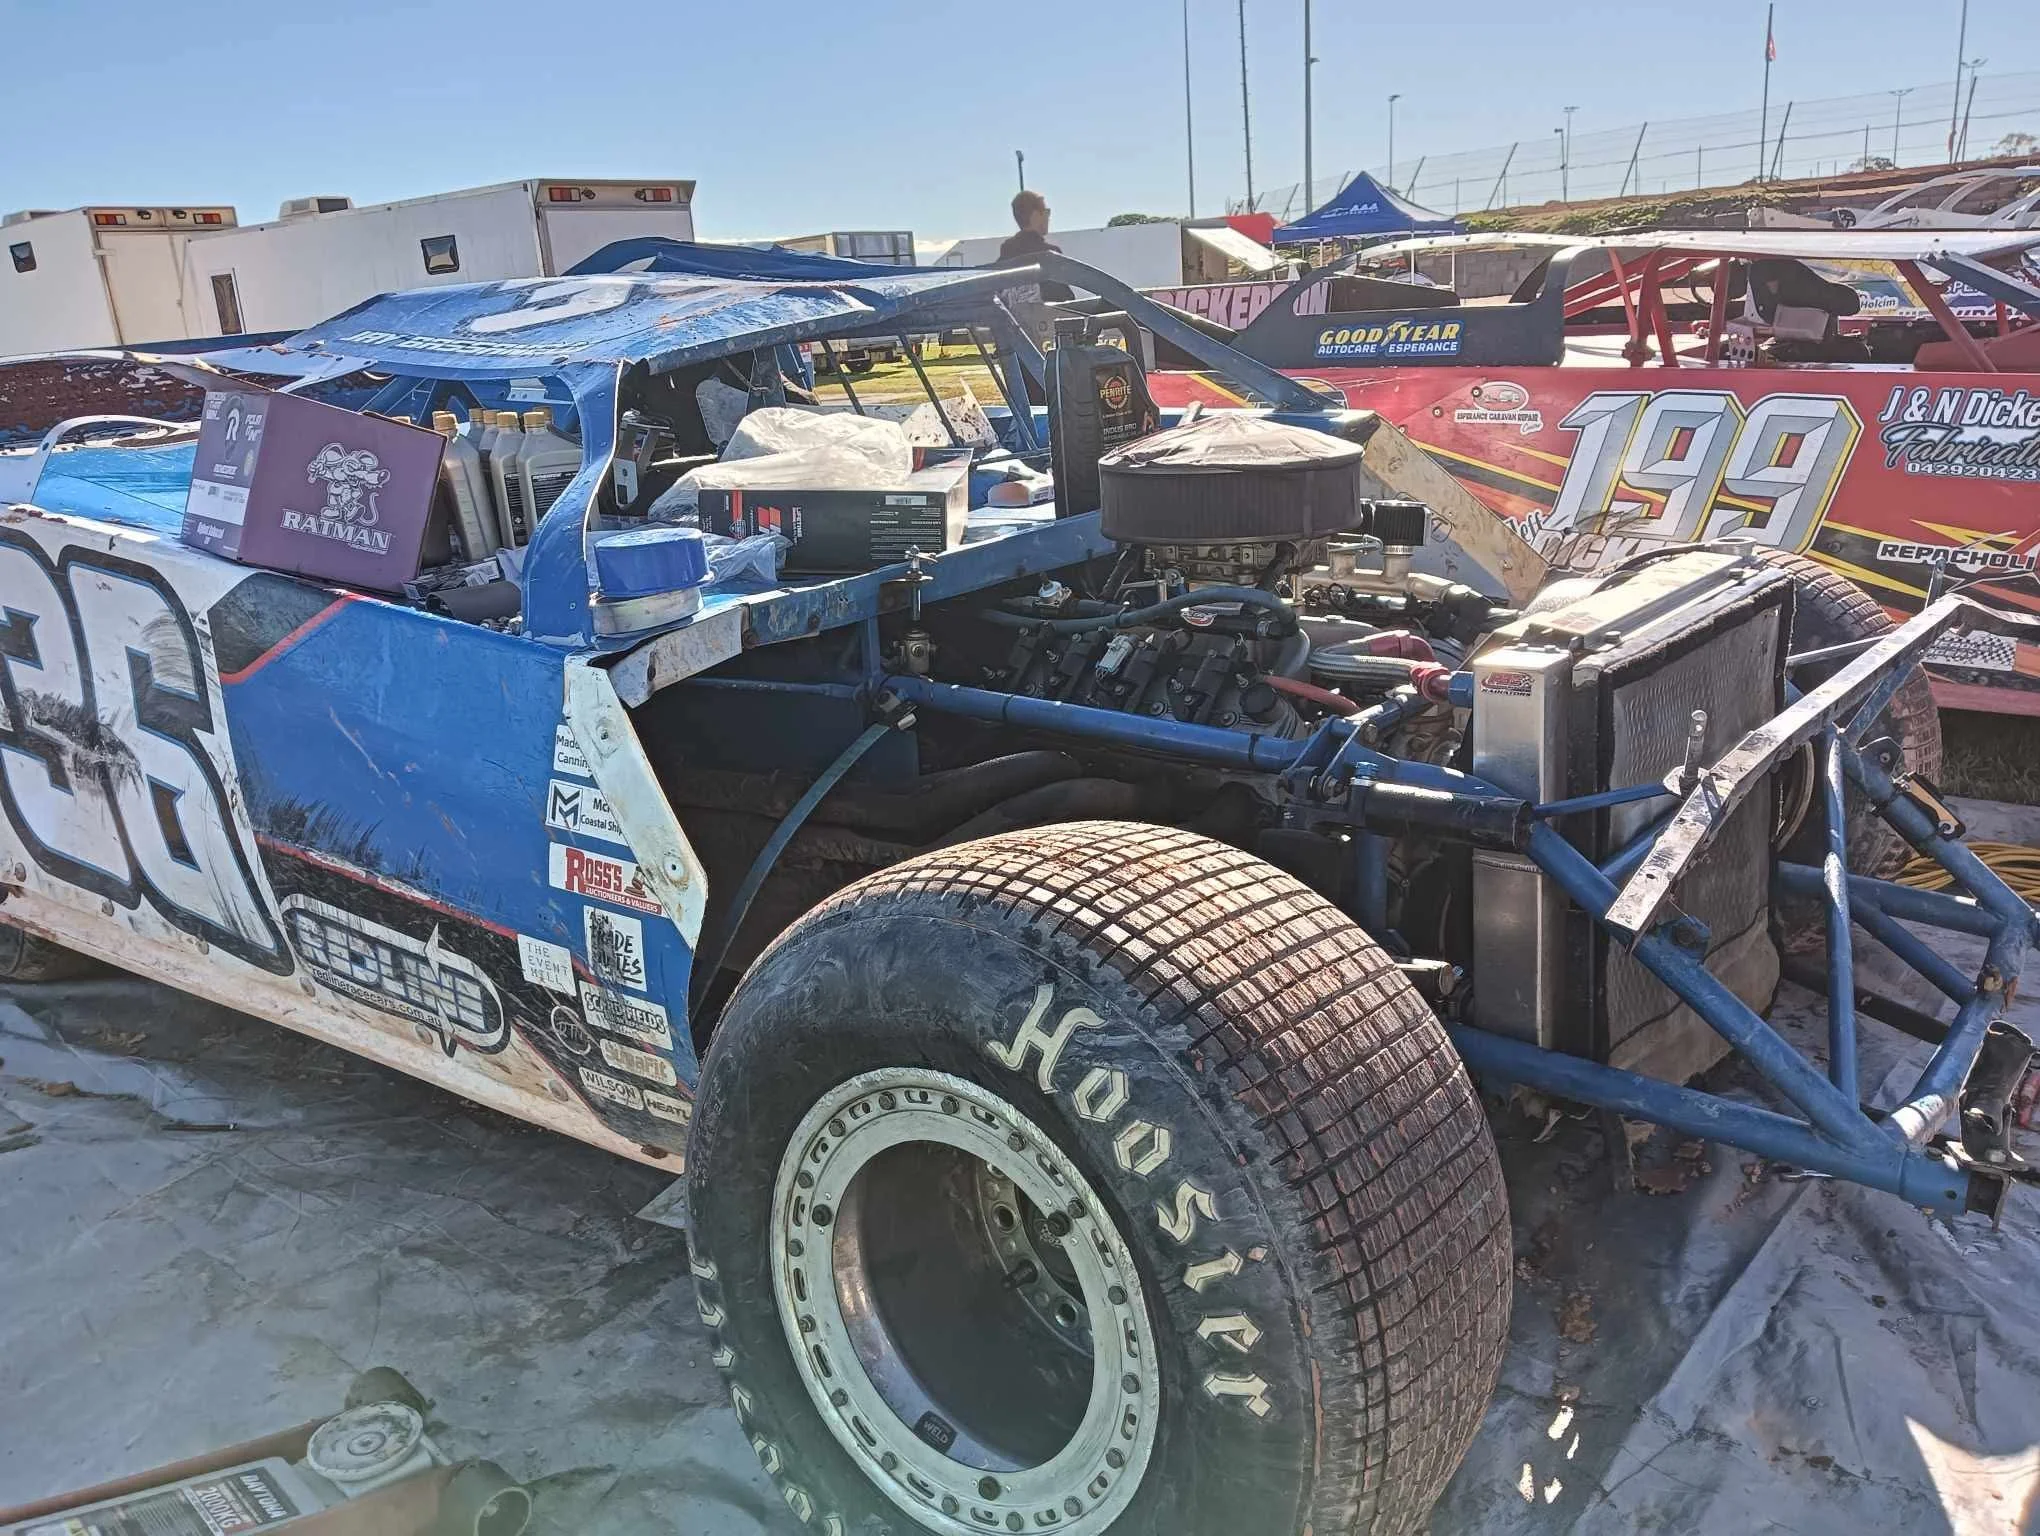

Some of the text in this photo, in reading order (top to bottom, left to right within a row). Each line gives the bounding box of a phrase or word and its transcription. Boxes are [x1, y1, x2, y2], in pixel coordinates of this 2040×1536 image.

[1860, 298, 1897, 309] Holcim
[1318, 341, 1458, 355] AUTOCARE ESPERANCE
[1099, 385, 1133, 399] PENRITE
[1880, 389, 1903, 422] J
[1903, 390, 1929, 423] &
[1931, 390, 1963, 424] N
[1558, 389, 1865, 555] 199
[280, 508, 393, 551] RATMAN
[1880, 544, 2037, 570] REPACHOLI
[557, 751, 592, 772] Cannin
[580, 814, 607, 830] Coastal
[585, 887, 626, 905] AUCTIONEERS
[527, 942, 550, 958] THE
[527, 955, 568, 977] EVENT
[312, 967, 443, 1028] redlineracecars.com.au
[582, 1069, 637, 1099] WILSON
[924, 1420, 949, 1444] WELD
[195, 1486, 241, 1528] 2000KG
[239, 1474, 288, 1519] DAYTONA
